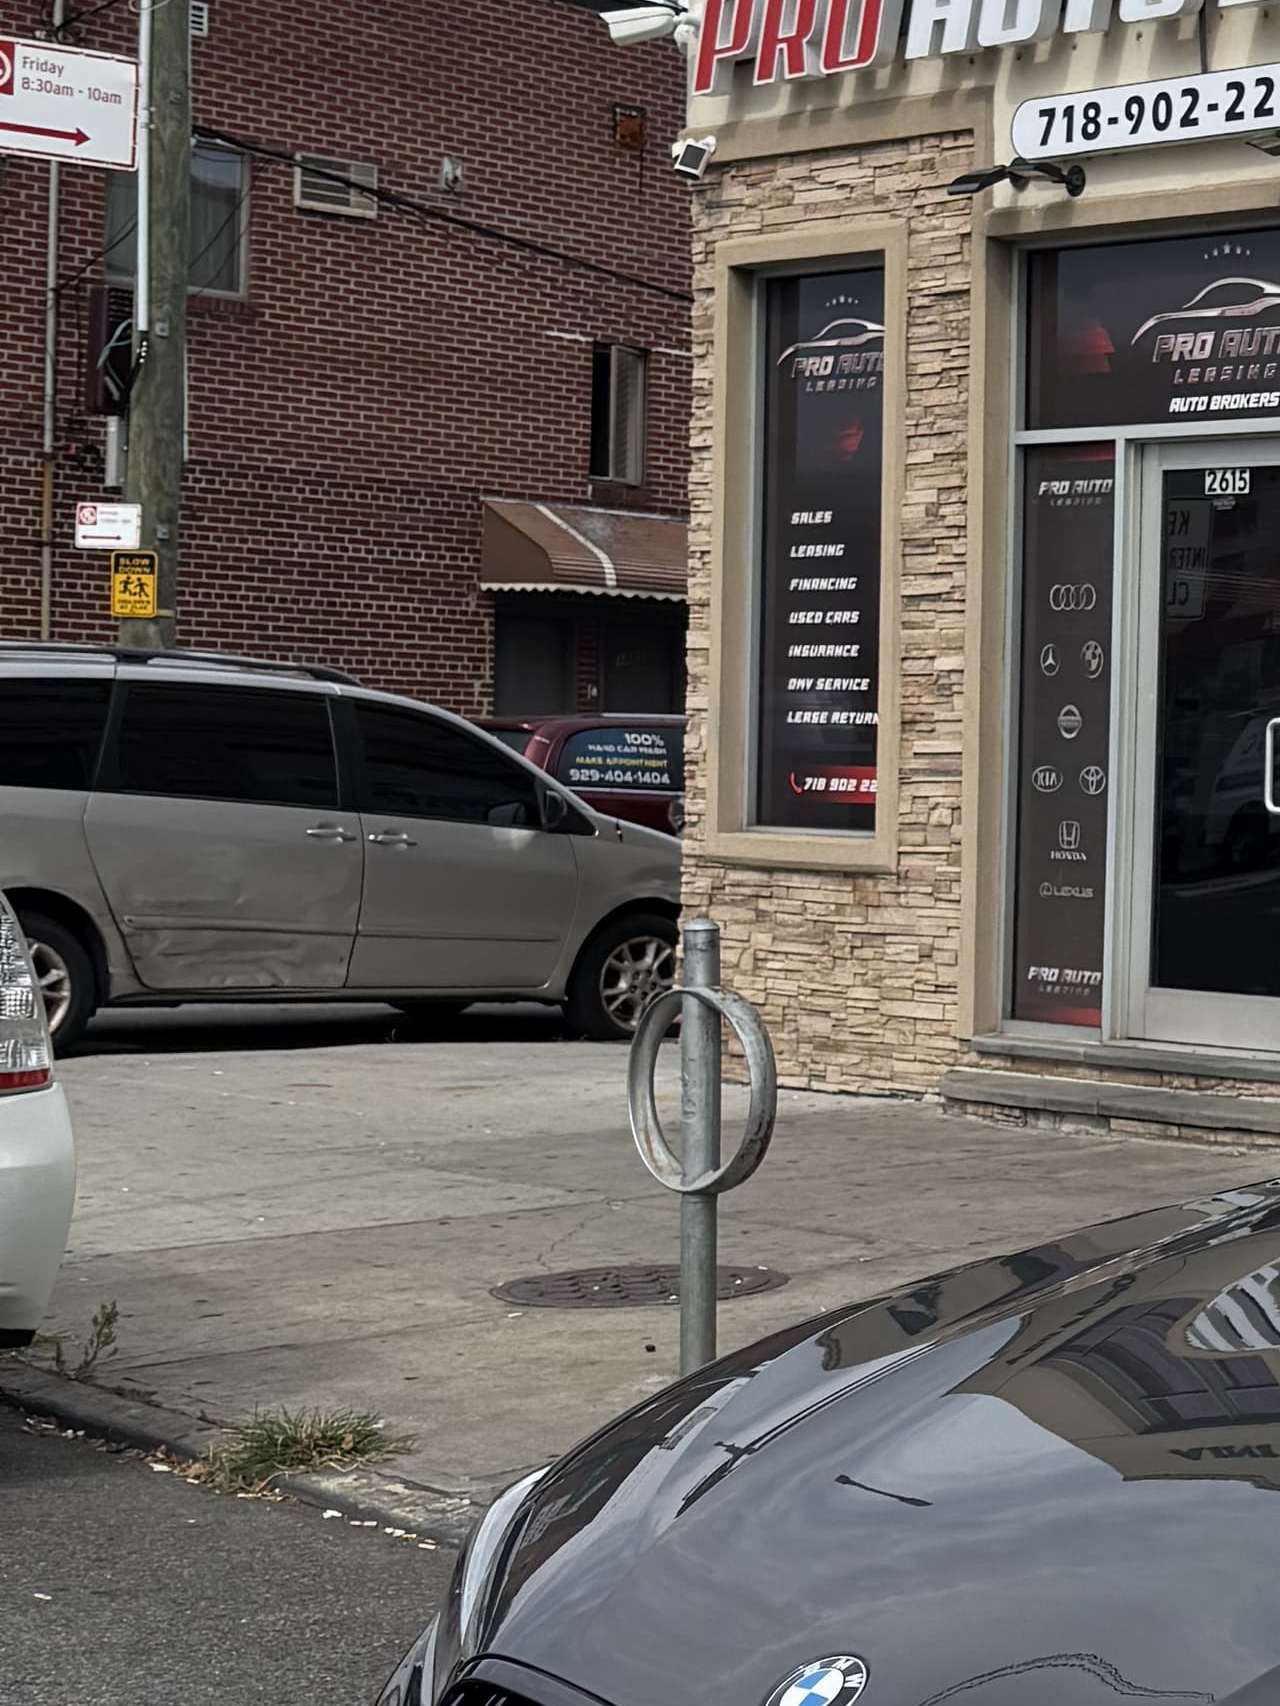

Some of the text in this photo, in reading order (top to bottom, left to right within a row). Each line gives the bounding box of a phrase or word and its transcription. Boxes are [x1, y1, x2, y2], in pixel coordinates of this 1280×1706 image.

[22, 56, 65, 77] Friday
[21, 77, 74, 97] 8:30am
[88, 87, 122, 104] 10am
[1152, 332, 1215, 363] PRO
[791, 352, 883, 378] PRO AUT
[1174, 363, 1277, 386] LEASING
[1169, 392, 1280, 414] AUTO BROKERS
[1039, 479, 1113, 495] PRO AUTO
[1207, 469, 1248, 493] 2615
[791, 511, 833, 524] SALES
[790, 544, 845, 557] LEASING
[789, 577, 858, 591] FINANCING
[789, 611, 860, 624] USED CARS
[788, 645, 860, 657] INSURANCE
[787, 678, 870, 690] DMV SERVICE
[787, 711, 829, 723] LEASE
[624, 733, 665, 747] 100%
[569, 768, 670, 784] 929-404-1404
[804, 777, 827, 791] 718
[829, 778, 856, 791] 902
[1050, 850, 1087, 861] HONDA
[1027, 966, 1101, 985] PRO AUTO
